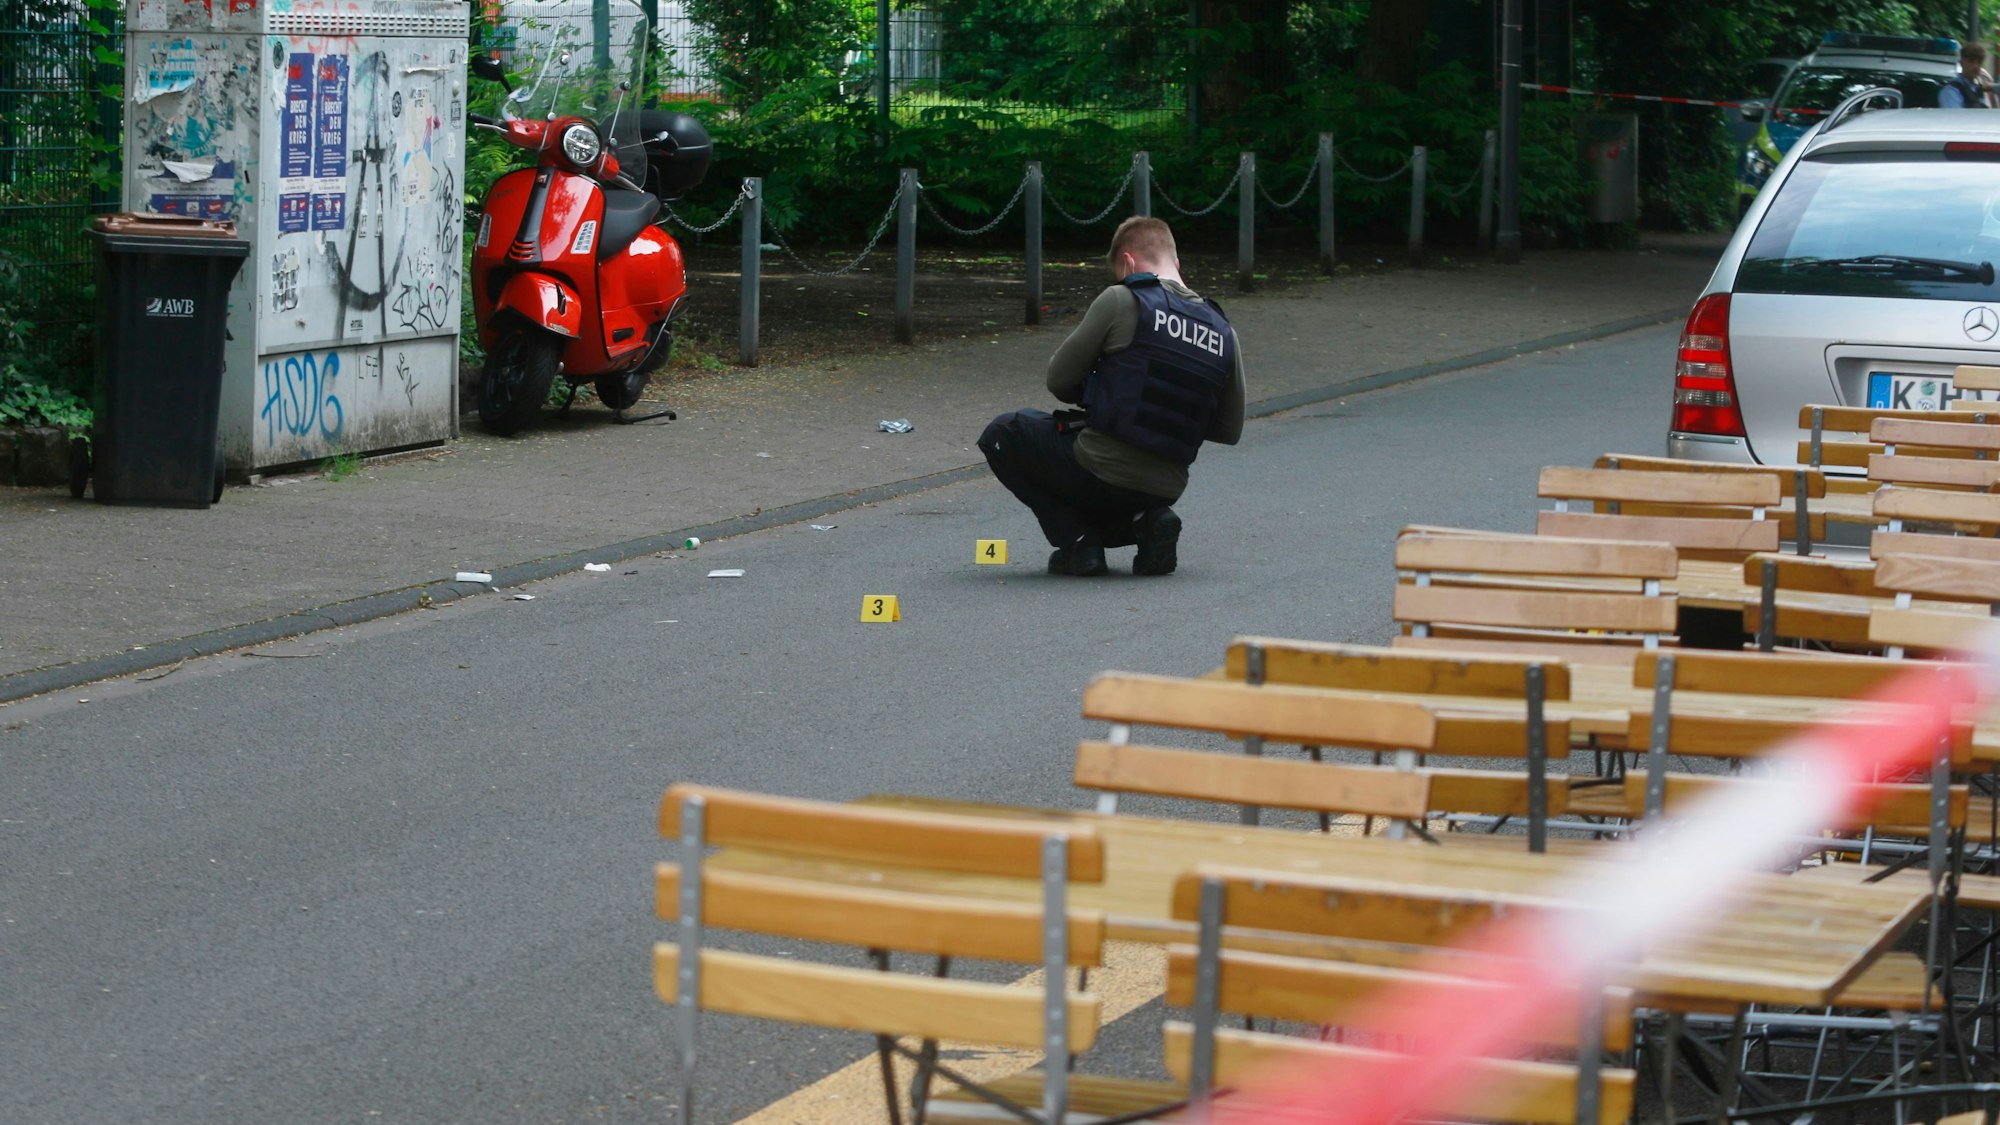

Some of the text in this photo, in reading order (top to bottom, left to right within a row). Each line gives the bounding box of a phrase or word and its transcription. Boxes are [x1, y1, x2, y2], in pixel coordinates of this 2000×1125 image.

[290, 100, 307, 113] BRECHT
[325, 101, 342, 114] BRECHT
[295, 115, 307, 128] DEN
[329, 116, 342, 130] DEN
[289, 131, 307, 144] KRIEG
[324, 132, 342, 144] KRIEG
[163, 299, 194, 314] AWB
[1154, 309, 1224, 357] POLIZEI
[1893, 380, 1916, 410] K
[985, 544, 995, 559] 4
[872, 599, 883, 616] 3
